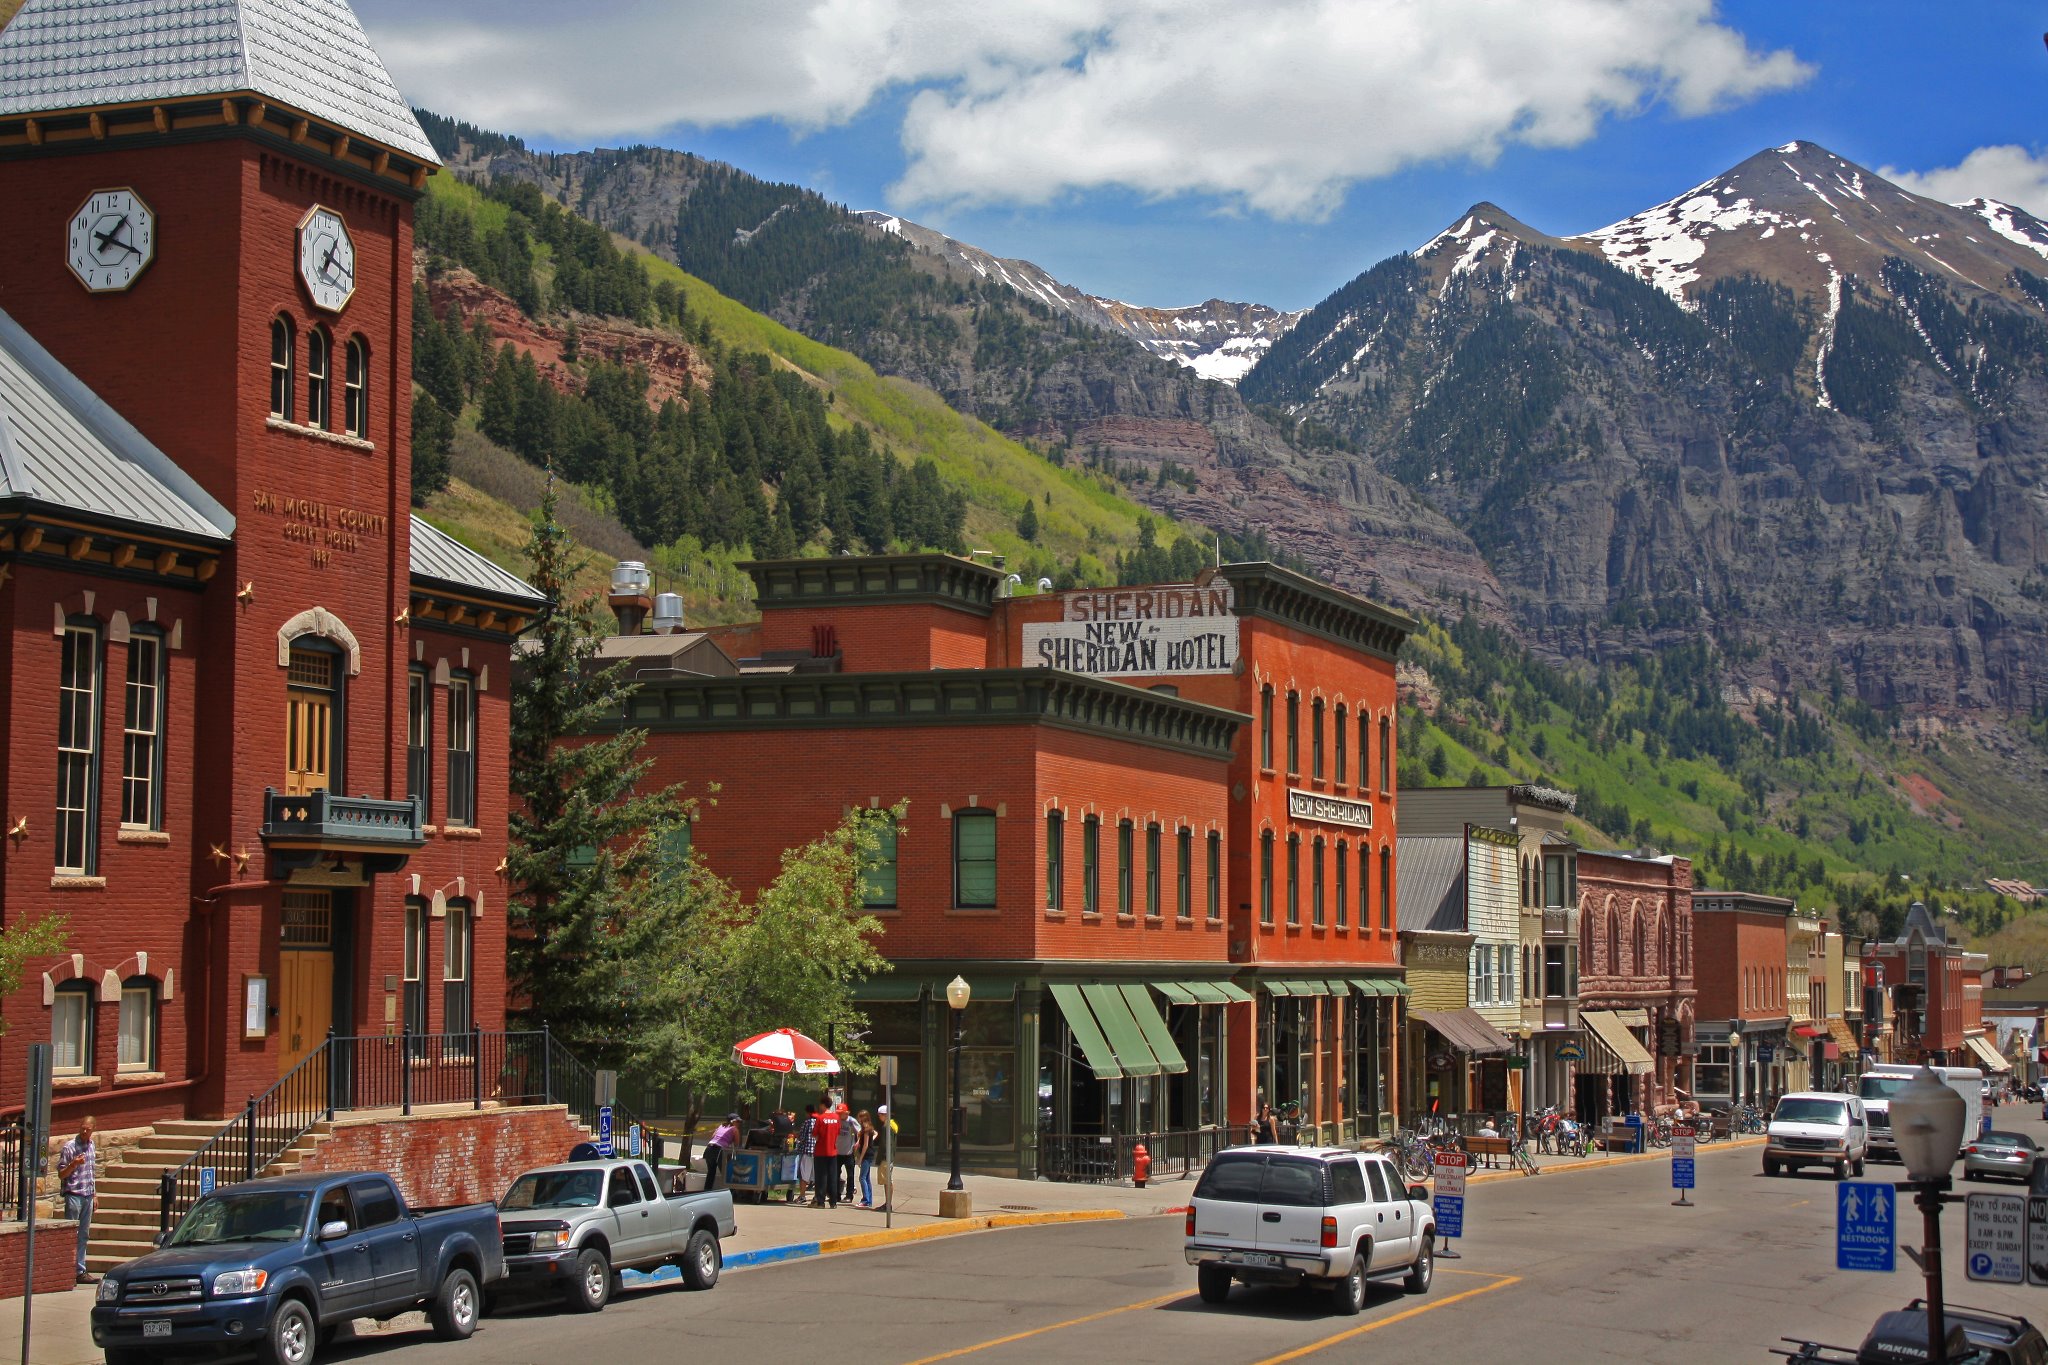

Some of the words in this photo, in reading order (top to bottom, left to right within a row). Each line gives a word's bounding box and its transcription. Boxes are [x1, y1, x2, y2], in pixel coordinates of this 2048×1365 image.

[91, 200, 100, 214] 11
[107, 194, 118, 208] 12
[77, 217, 88, 230] 10
[139, 212, 145, 225] 2
[314, 215, 320, 229] 11
[324, 215, 332, 229] 12
[143, 232, 149, 245] 3
[305, 227, 313, 241] 10
[72, 237, 78, 249] 9
[344, 241, 349, 255] 2
[302, 246, 307, 258] 9
[77, 256, 83, 269] 8
[89, 269, 94, 283] 7
[124, 267, 130, 280] 5
[305, 266, 310, 279] 8
[106, 273, 112, 286] 6
[324, 291, 329, 304] 6
[253, 489, 278, 510] SAN
[285, 498, 330, 521] MIGUEL
[339, 508, 388, 533] COUNTY
[286, 522, 319, 538] COURT
[327, 530, 360, 547] HOUSE
[313, 548, 332, 562] 1887
[1071, 589, 1228, 622] SHERIDAN
[1085, 621, 1144, 646] NEW
[1038, 637, 1158, 673] SHERIDAN
[1166, 633, 1231, 670] HOTEL
[1290, 795, 1313, 815] NEW
[1315, 799, 1368, 824] SHERIDAN
[1674, 1128, 1692, 1136] STOP
[1439, 1155, 1463, 1165] STOP
[1969, 1200, 1984, 1209] PAY
[1988, 1201, 1998, 1210] TO
[2001, 1202, 2021, 1212] PARK
[2030, 1202, 2046, 1219] NO
[1973, 1212, 1990, 1222] THIS
[1993, 1213, 2018, 1224] BLOCK
[1856, 1225, 1885, 1234] PUBLIC
[1841, 1234, 1890, 1244] RESTROOMS
[1969, 1240, 1993, 1250] EXCEPT
[1996, 1242, 2022, 1252] SUNDAY
[1976, 1257, 1989, 1271] P
[1877, 1342, 1929, 1358] YAKIMA
